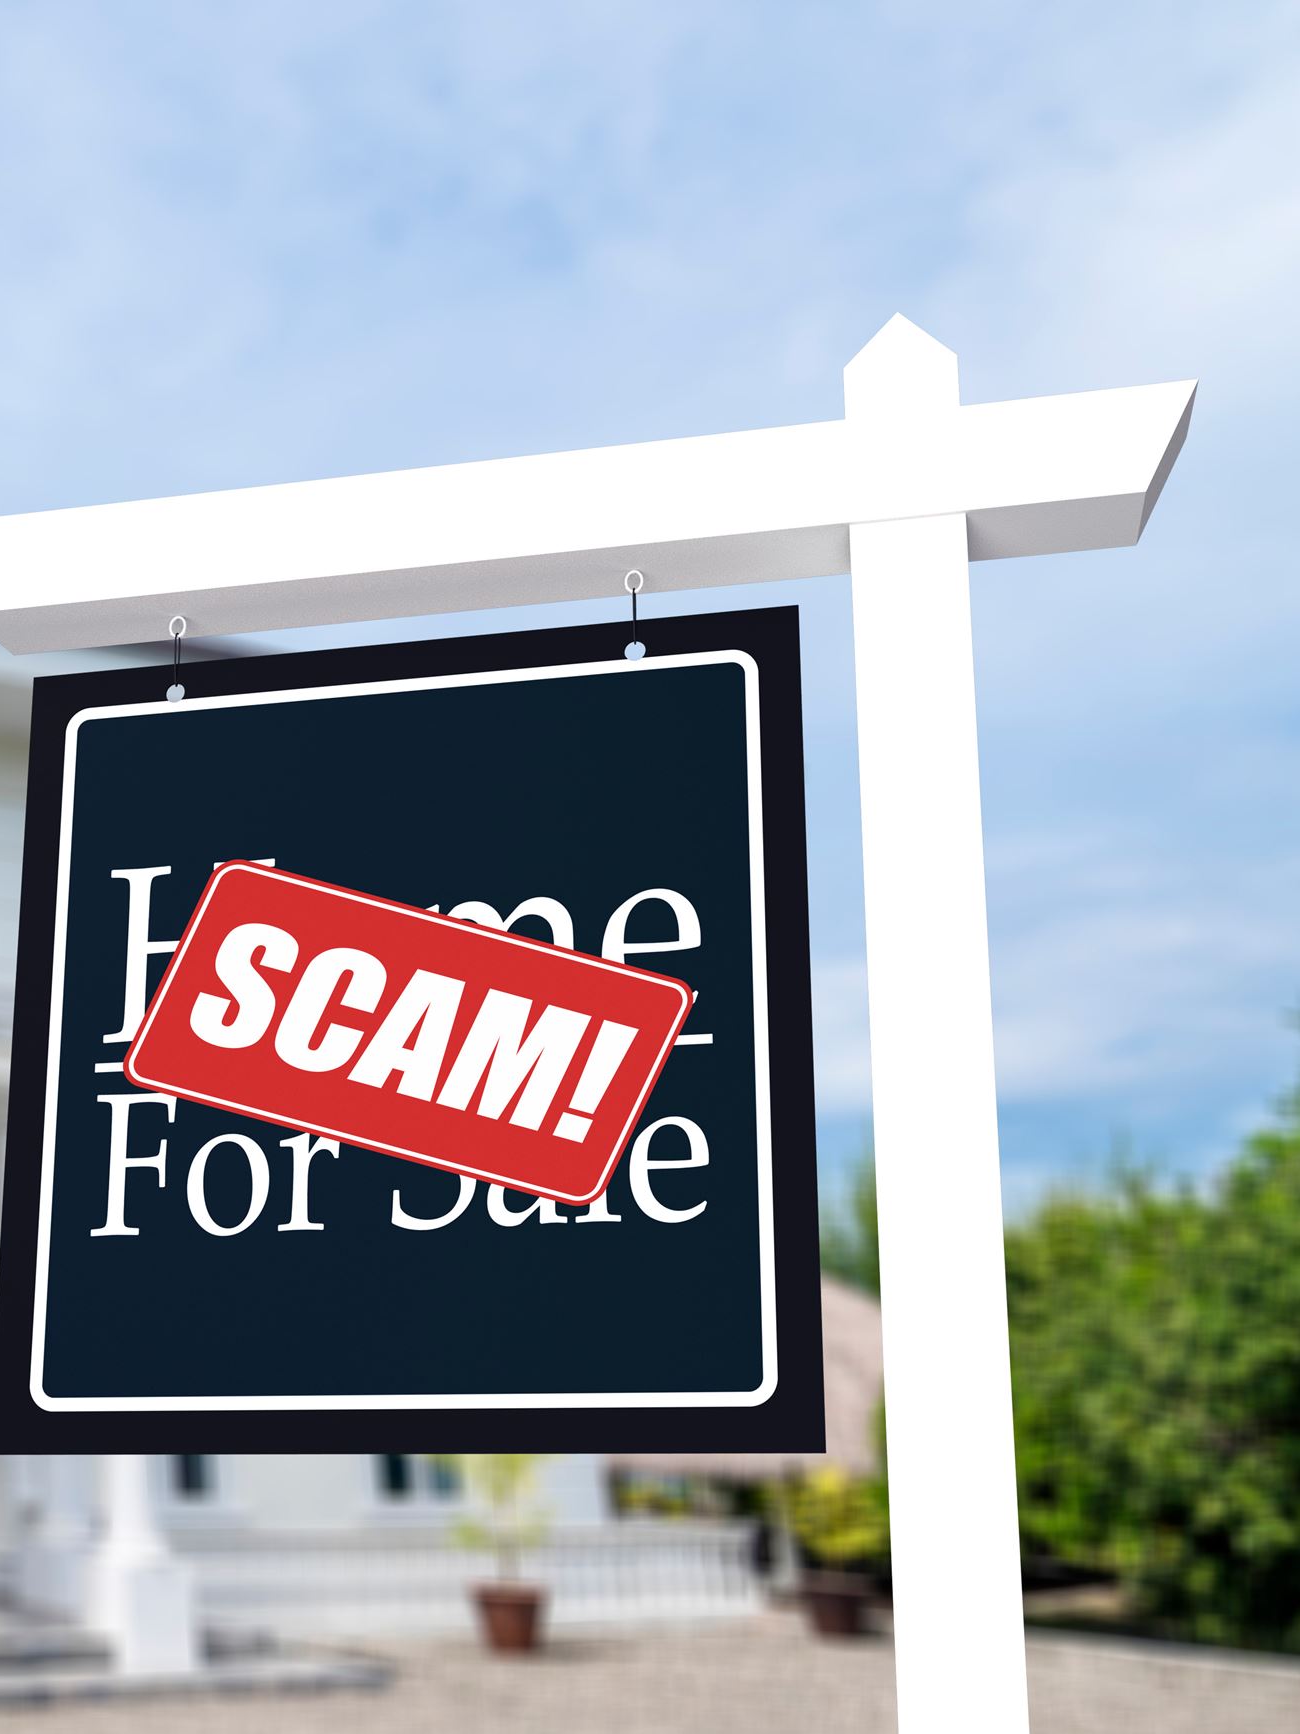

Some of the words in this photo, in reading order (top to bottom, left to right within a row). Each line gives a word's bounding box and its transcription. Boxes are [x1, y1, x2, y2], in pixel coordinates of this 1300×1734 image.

[102, 858, 702, 1044] He
[189, 922, 639, 1144] SCAM!
[90, 1092, 341, 1237] For
